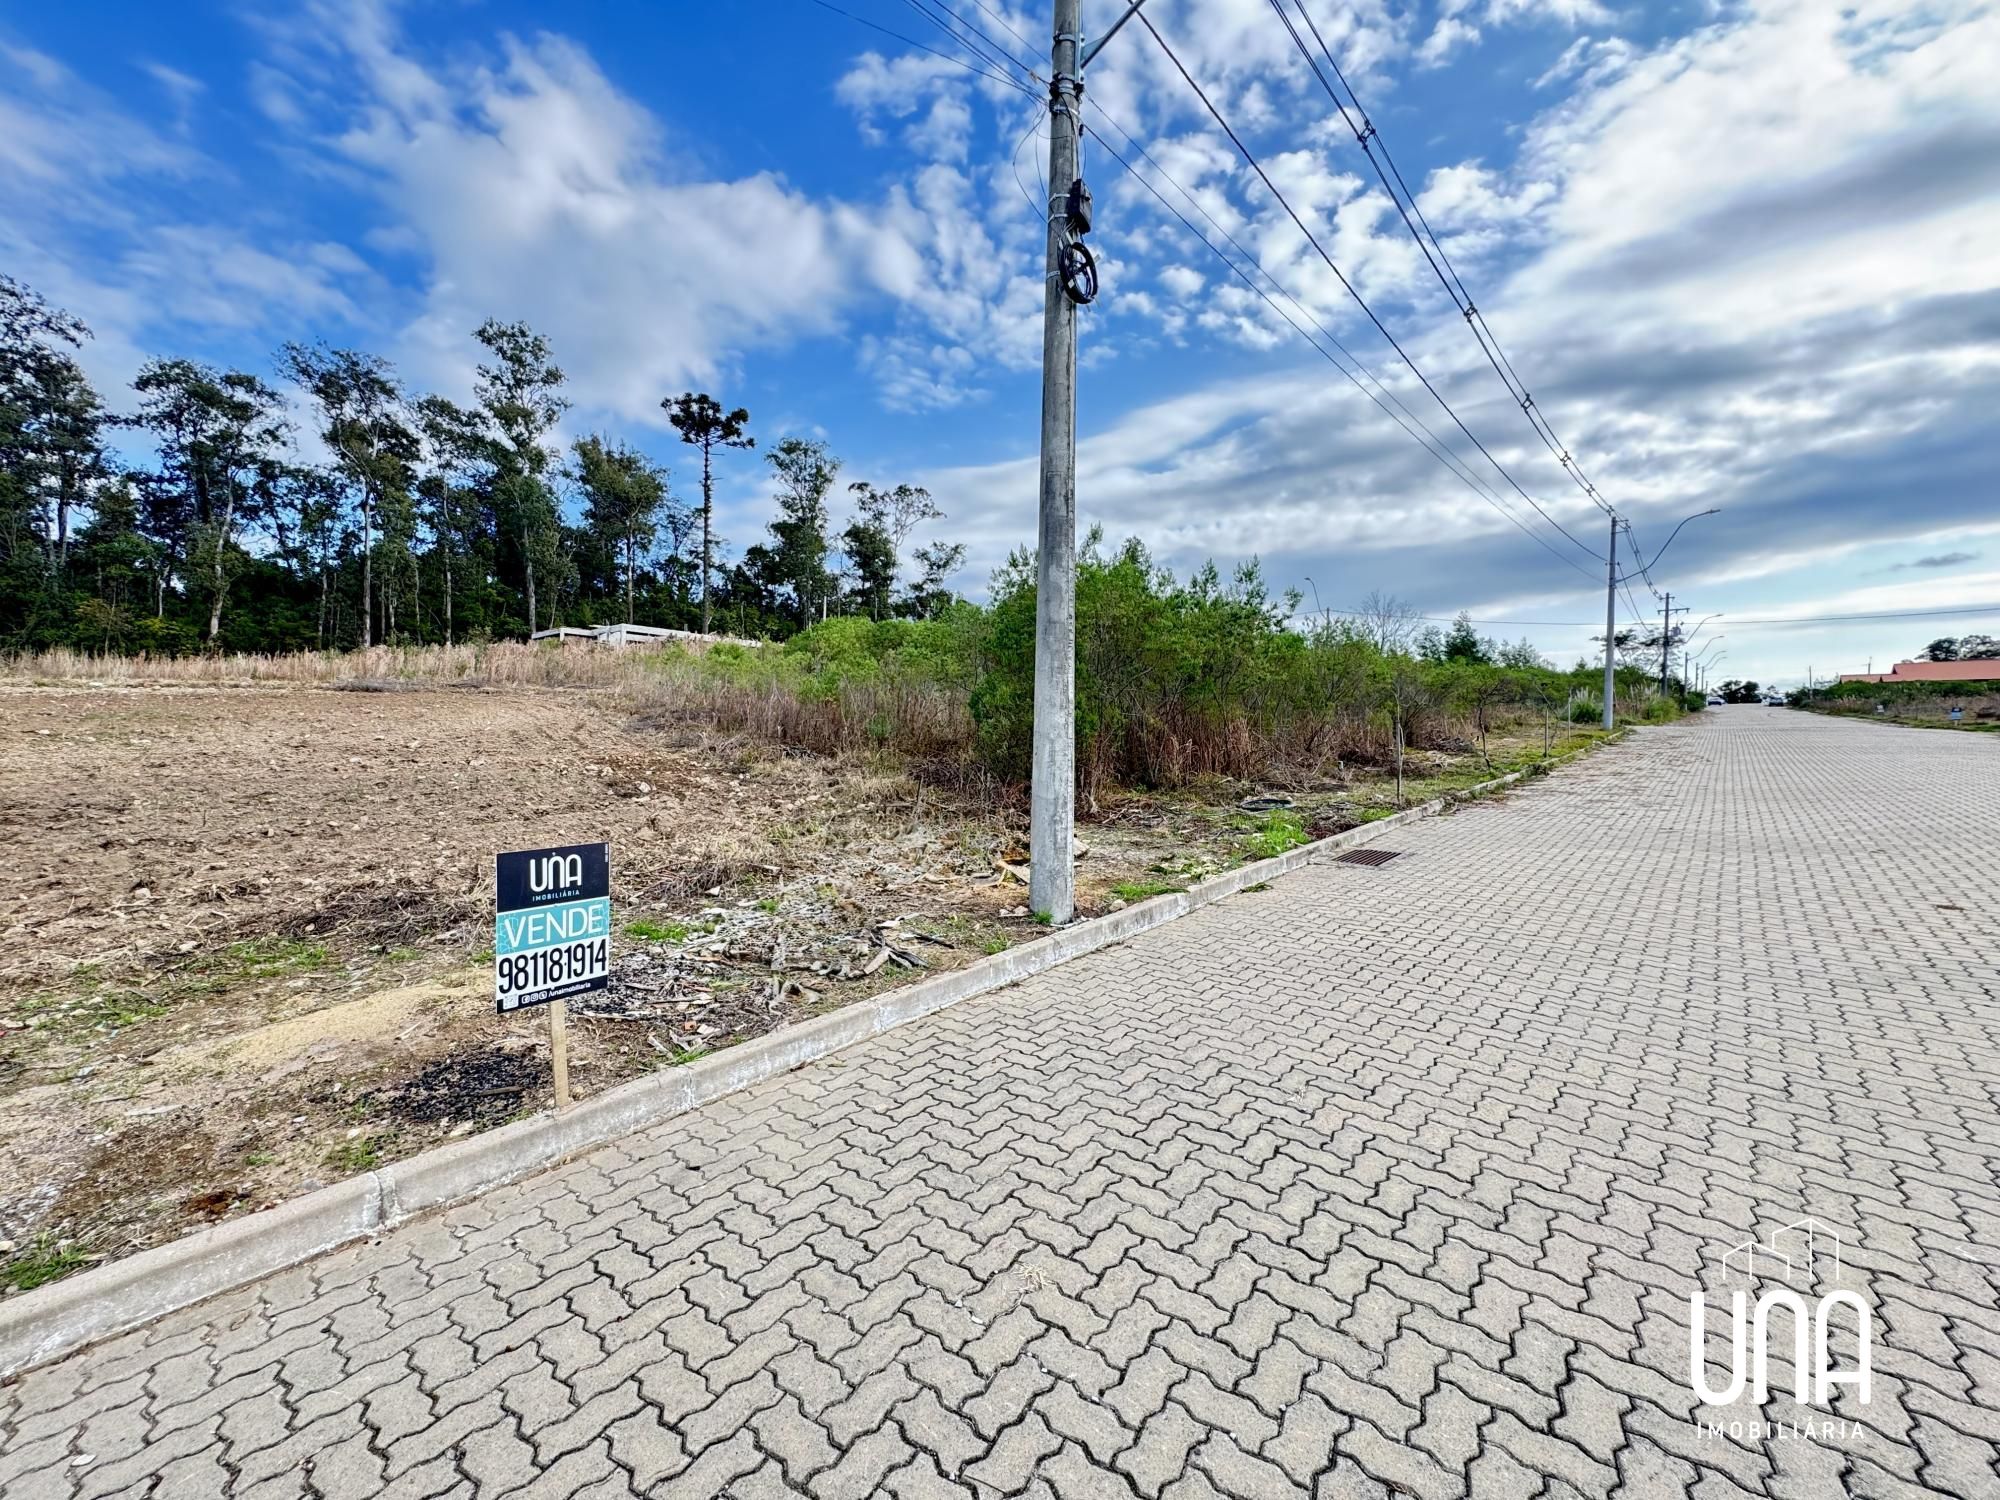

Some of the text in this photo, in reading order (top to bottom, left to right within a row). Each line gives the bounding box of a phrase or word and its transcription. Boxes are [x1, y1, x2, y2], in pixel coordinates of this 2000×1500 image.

[530, 853, 582, 892] UNA
[532, 889, 580, 902] IMOBILIÁRIA
[504, 903, 604, 948] VENDE
